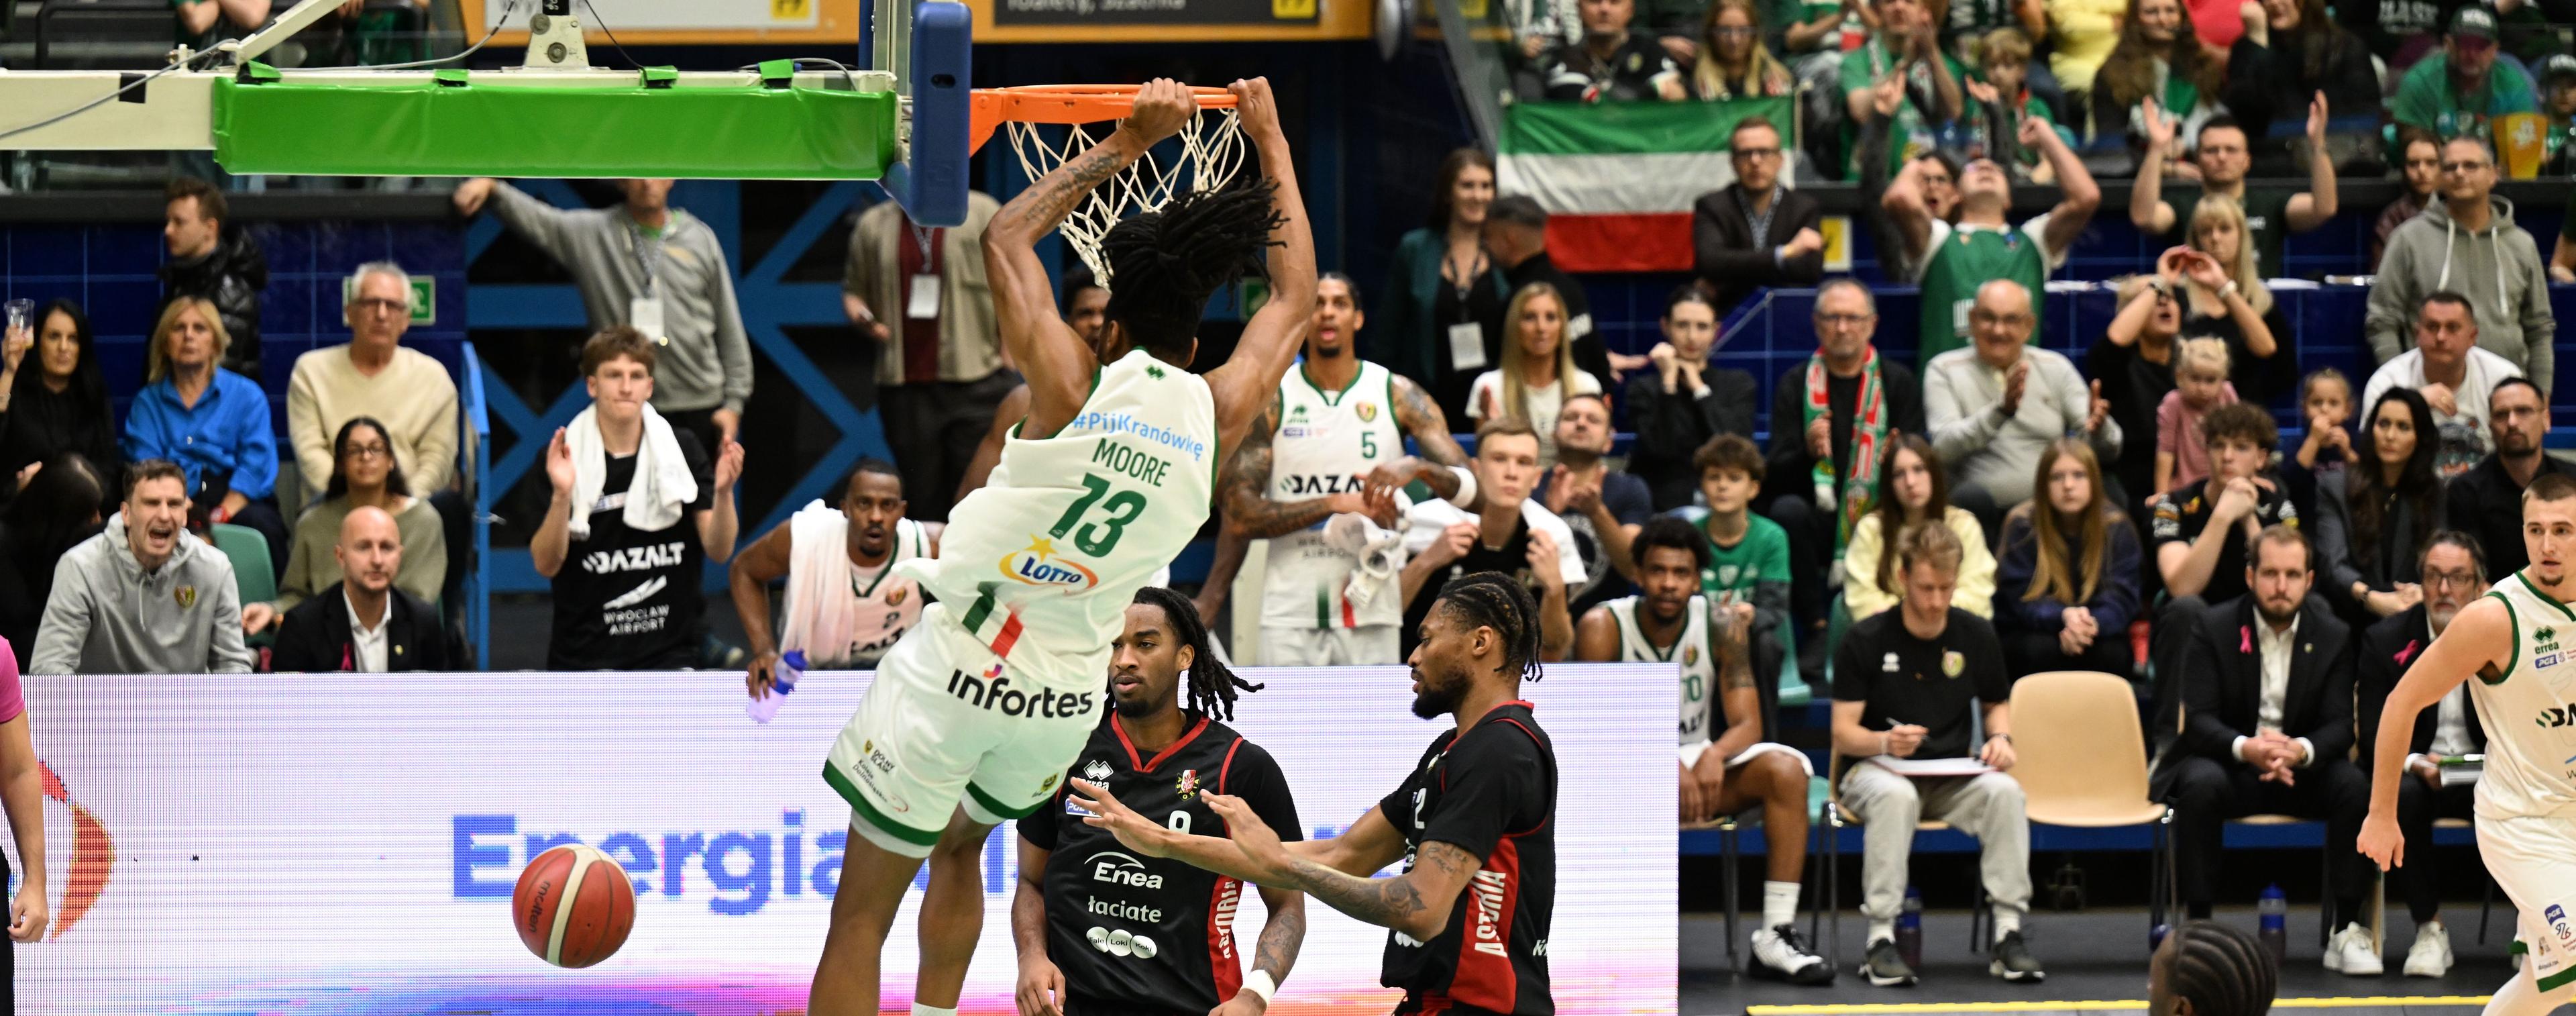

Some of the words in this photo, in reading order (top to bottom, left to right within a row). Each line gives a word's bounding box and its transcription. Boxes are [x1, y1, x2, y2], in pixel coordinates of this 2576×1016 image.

[1073, 411, 1203, 462] #PijKranówkę
[1362, 431, 1377, 459] 5
[1092, 438, 1171, 487] MOORE
[1049, 472, 1147, 558] 13
[582, 542, 686, 574] BAZALT
[1020, 556, 1082, 583] LOTTO
[609, 617, 666, 636] AIRPORT
[2534, 641, 2559, 655] errea
[2538, 656, 2555, 666] PGE
[1176, 776, 1199, 800] ASTORIA
[1093, 862, 1163, 890] Enea
[1088, 895, 1162, 923] łaciate
[1110, 938, 1128, 946] Loki
[1135, 942, 1152, 952] Koki
